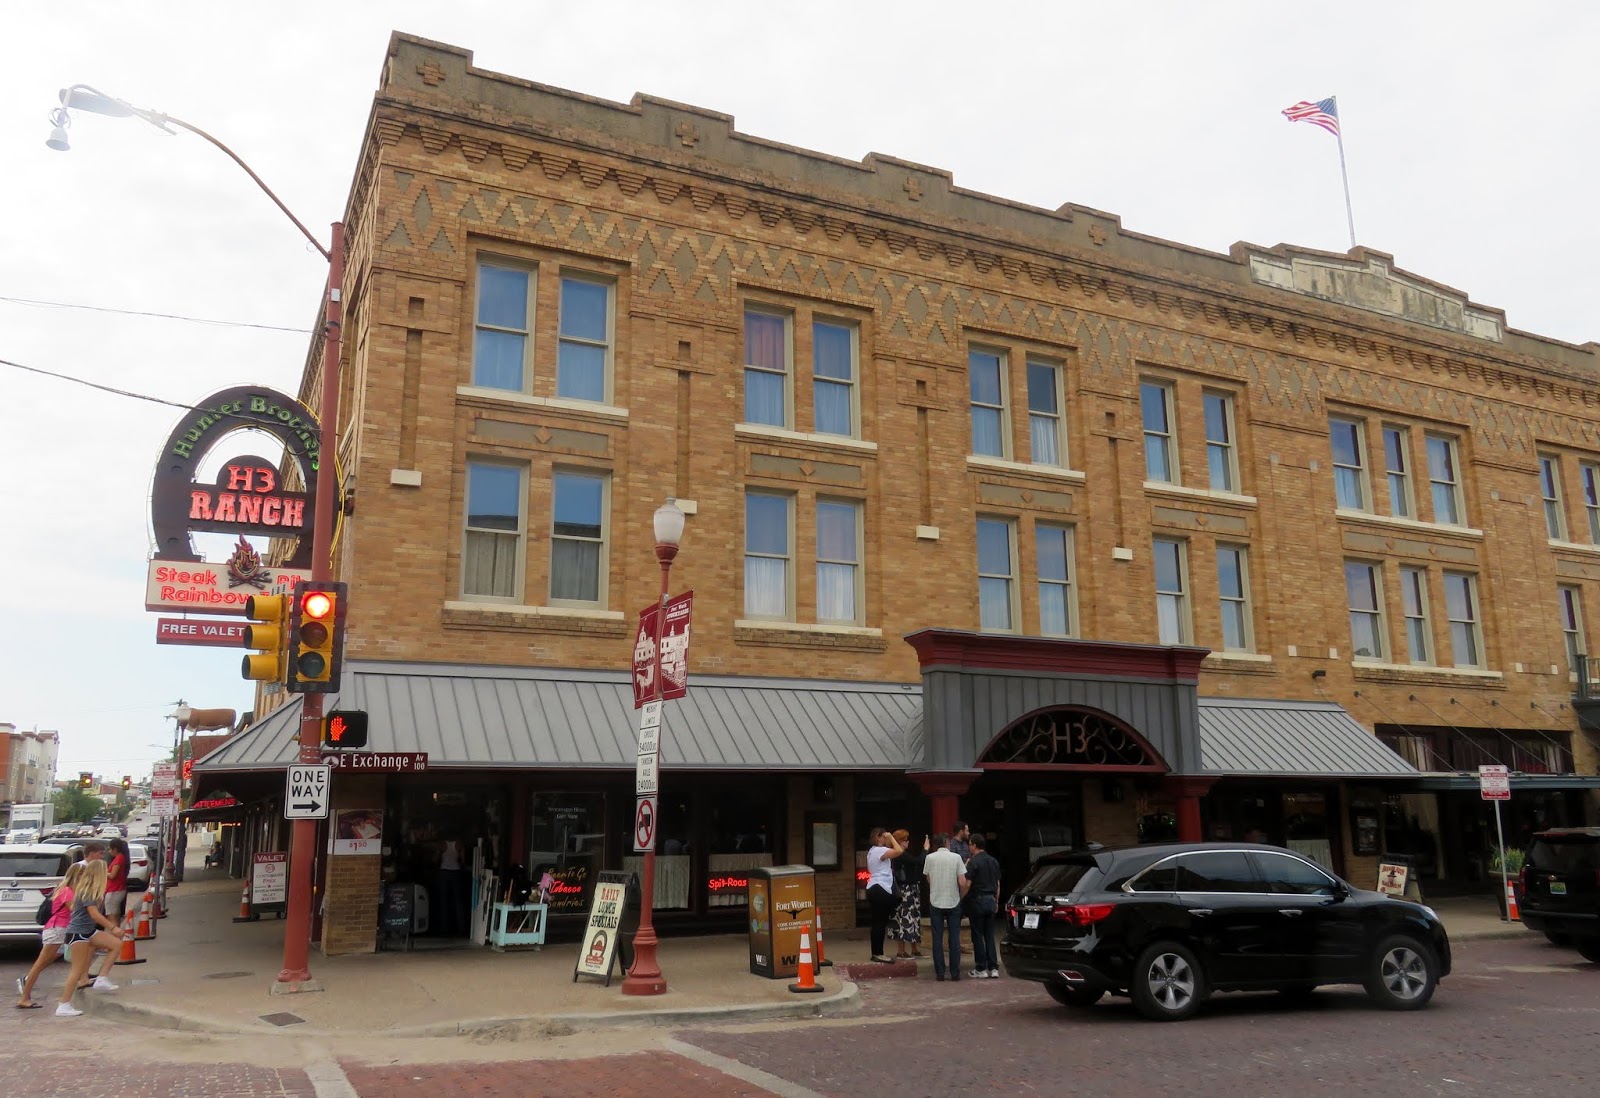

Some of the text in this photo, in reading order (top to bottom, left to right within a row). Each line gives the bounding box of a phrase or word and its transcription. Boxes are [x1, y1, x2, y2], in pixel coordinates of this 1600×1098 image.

[173, 400, 243, 459] Hunter
[227, 465, 276, 493] H3
[189, 490, 305, 527] RANCH
[155, 566, 217, 585] Steak
[161, 623, 245, 637] FREE VALET
[1052, 722, 1088, 754] H3
[340, 754, 347, 768] E
[352, 753, 409, 771] Exchange
[292, 770, 325, 783] ONE
[291, 785, 325, 798] WAY
[550, 880, 582, 894] Tobacco
[600, 888, 621, 901] DAILY
[597, 902, 617, 915] LUNCH
[775, 900, 812, 911] FORT WORTH
[590, 915, 618, 929] SPECIALS
